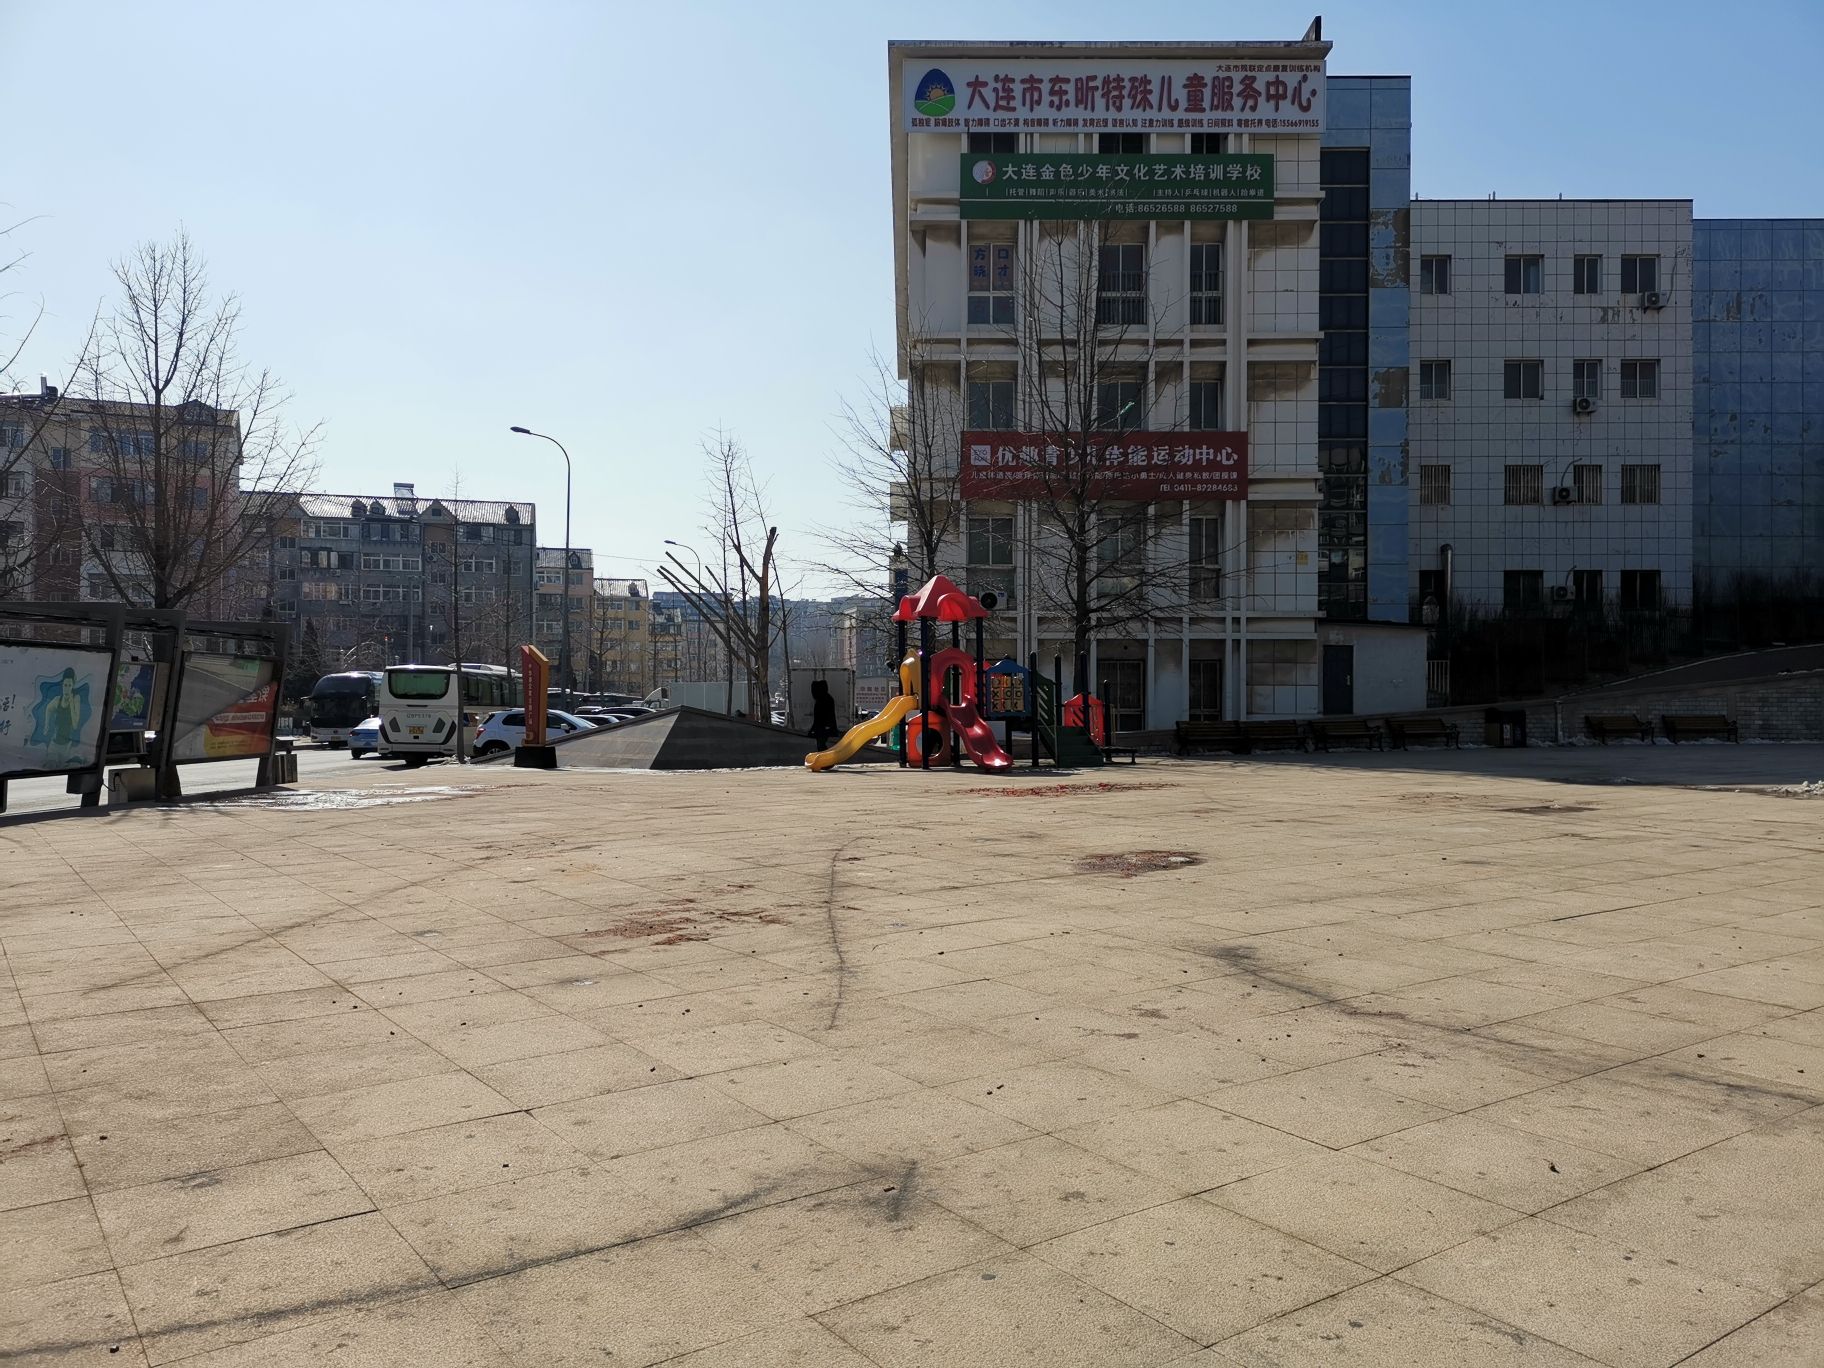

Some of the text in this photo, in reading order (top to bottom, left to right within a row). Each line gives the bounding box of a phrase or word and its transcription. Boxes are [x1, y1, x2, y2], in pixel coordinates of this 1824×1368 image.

[966, 73, 1318, 113] 大连市东昕特殊儿童服务中心
[1002, 163, 1262, 181] 大连金色少年文化艺术培训学校
[1190, 203, 1238, 213] 86527588
